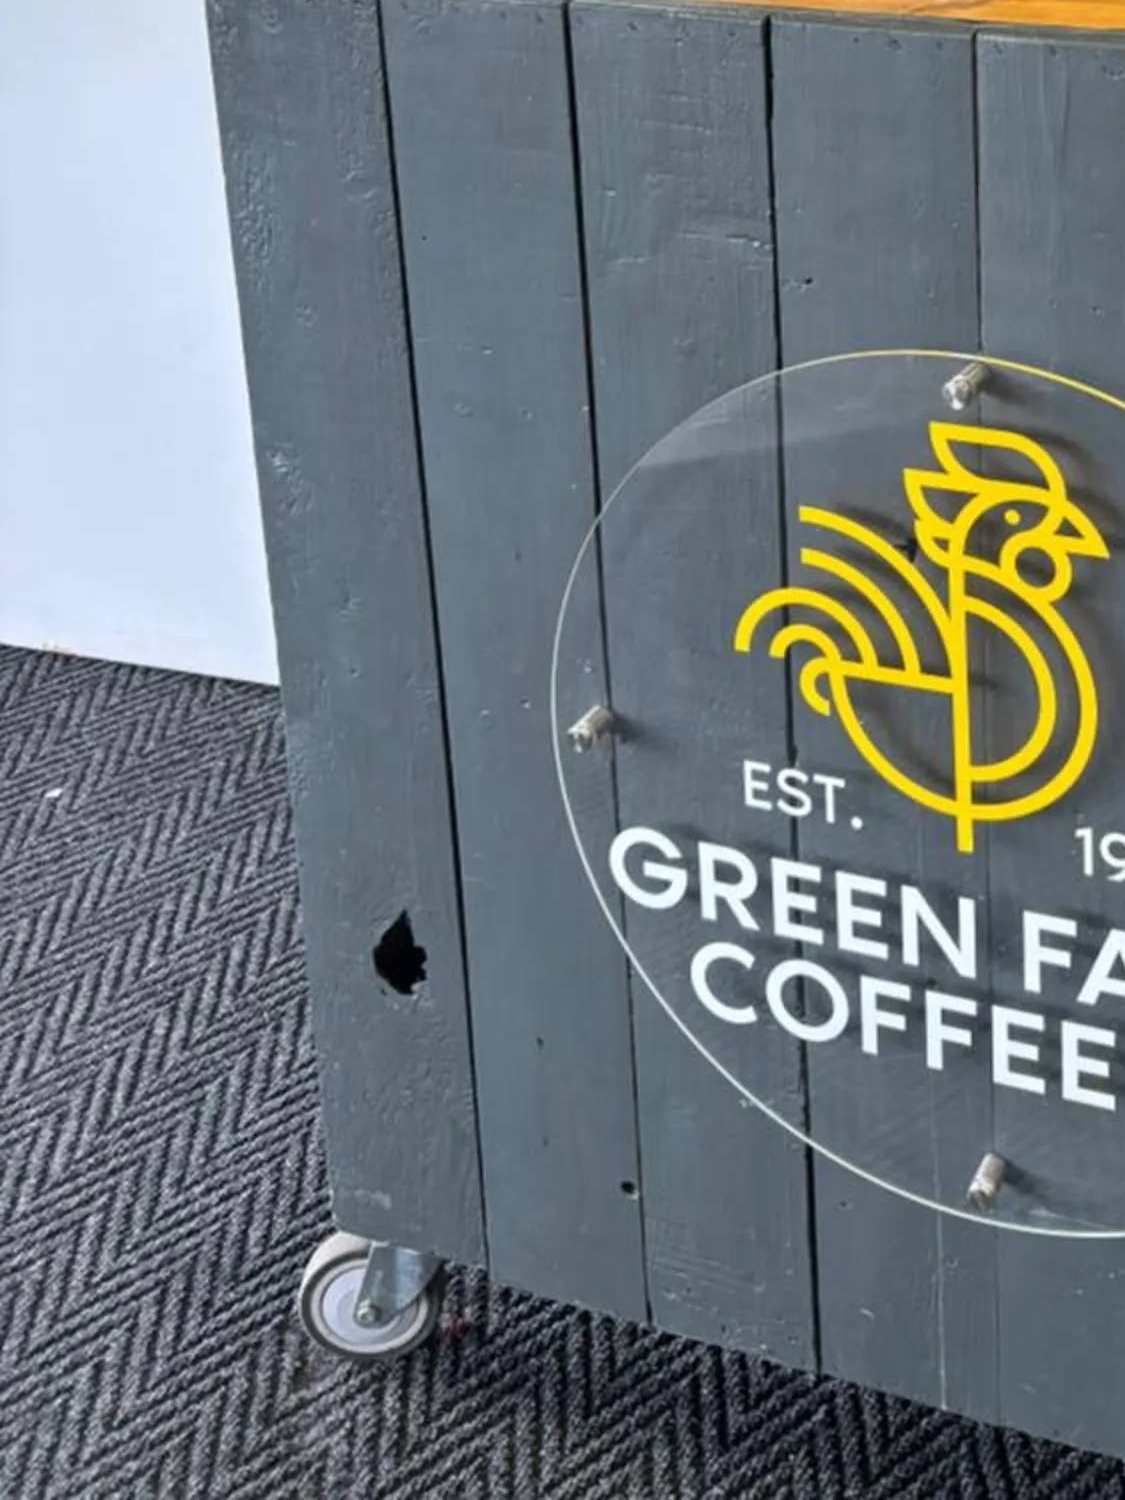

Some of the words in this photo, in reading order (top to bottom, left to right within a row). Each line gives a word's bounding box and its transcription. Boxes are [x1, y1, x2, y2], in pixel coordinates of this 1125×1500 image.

[742, 759, 865, 832] EST.
[608, 826, 978, 980] GREEN
[689, 941, 1117, 1112] COFFEE
